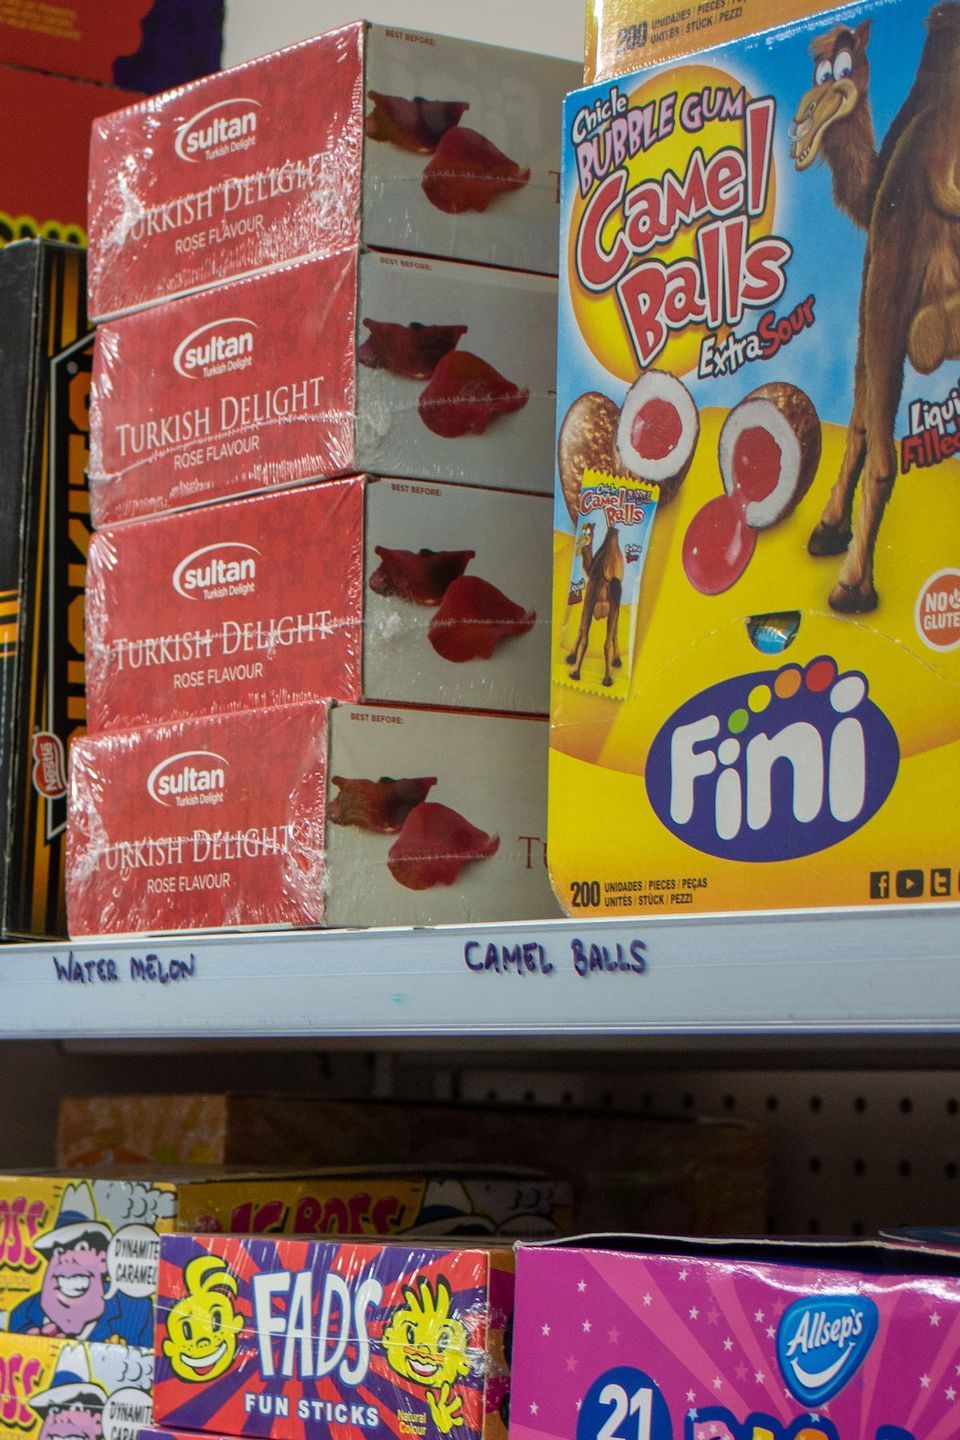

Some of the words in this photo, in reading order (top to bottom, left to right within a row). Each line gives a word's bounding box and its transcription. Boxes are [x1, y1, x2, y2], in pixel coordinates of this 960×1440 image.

[572, 85, 628, 144] Chicle
[186, 112, 256, 153] sultan
[205, 147, 229, 160] Turkish
[230, 136, 256, 154] Delight
[576, 91, 678, 198] BUBBLE
[680, 86, 746, 133] GUM
[175, 228, 206, 254] ROSE
[208, 213, 264, 247] FLAVOUR
[617, 216, 793, 368] Balls
[184, 332, 253, 369] sultan
[697, 329, 762, 379] Extra
[758, 295, 816, 358] Sour
[203, 364, 227, 378] Turkish
[228, 355, 252, 374] Delight
[116, 406, 211, 457] TURKISH
[221, 376, 325, 431] DELIGHT
[174, 445, 204, 470] ROSE
[206, 435, 260, 463] FLAVOUR
[391, 483, 410, 493] BEST
[603, 503, 645, 527] Balls
[184, 558, 255, 590] sultan
[203, 588, 228, 600] Turkish
[229, 582, 255, 597] Delight
[925, 591, 947, 612] NO
[924, 613, 960, 631] GLUTE
[114, 629, 212, 671] TURKISH
[221, 610, 333, 655] DELIGHT
[173, 670, 205, 688] ROSE
[207, 662, 263, 686] FLAVOUR
[350, 712, 369, 722] BEST
[669, 674, 866, 840] Fini
[158, 768, 224, 796] sultan
[147, 876, 177, 893] ROSE
[179, 872, 230, 891] FLAVOUR
[570, 881, 601, 908] 200
[604, 881, 643, 893] UNIDADES
[648, 879, 676, 891] PIECES
[682, 877, 708, 891] PEÇAS
[670, 893, 693, 904] PEZZI
[53, 952, 118, 984] WATER
[129, 950, 197, 983] MELON
[464, 940, 554, 977] CAMEL
[571, 938, 650, 977] BALLS
[115, 1238, 160, 1260] DYNAMITE
[252, 1269, 385, 1387] FADS
[786, 1308, 863, 1358] Allsep's
[244, 1391, 290, 1415] FUN
[297, 1398, 380, 1427] STICKS
[397, 1409, 427, 1425] Natural
[398, 1422, 427, 1437] Colour
